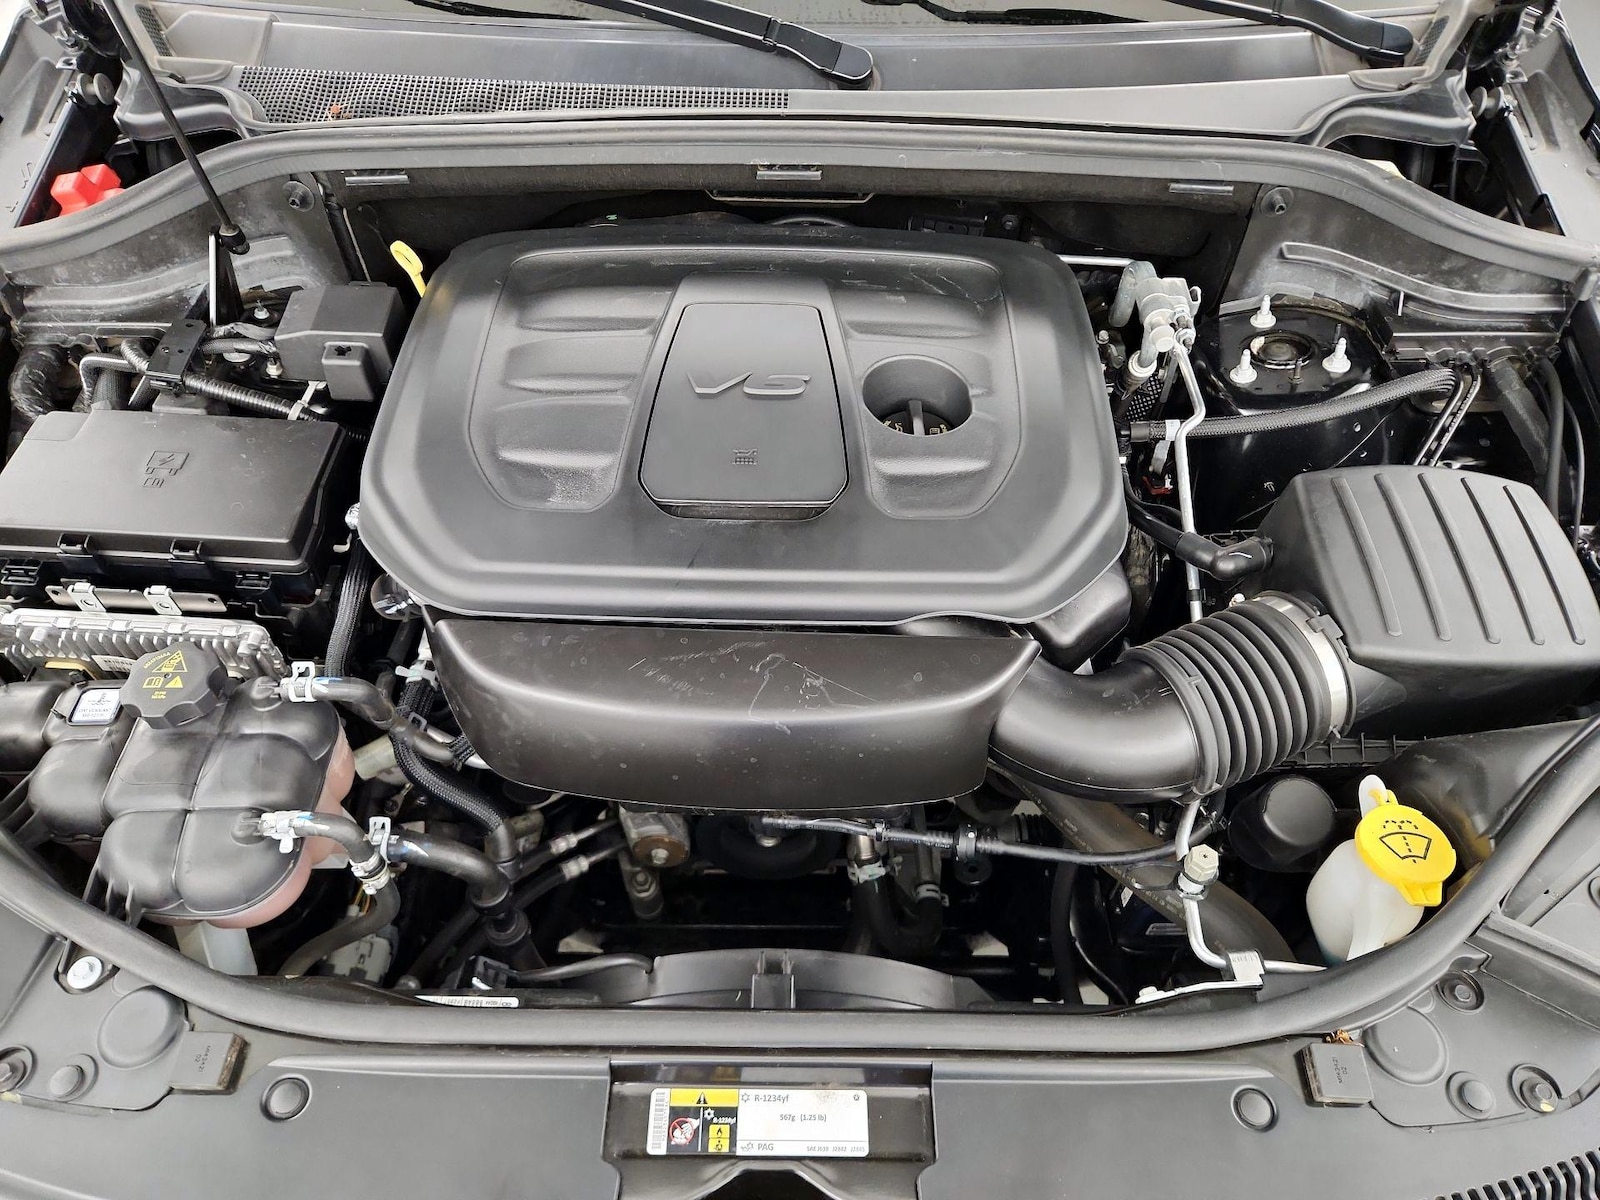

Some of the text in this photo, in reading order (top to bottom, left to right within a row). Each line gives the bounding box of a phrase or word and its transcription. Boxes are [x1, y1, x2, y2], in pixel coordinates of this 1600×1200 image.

[685, 371, 812, 397] V6
[754, 1094, 789, 1104] R-1234yf
[779, 1113, 796, 1122] 567g
[757, 1142, 774, 1151] PAG
